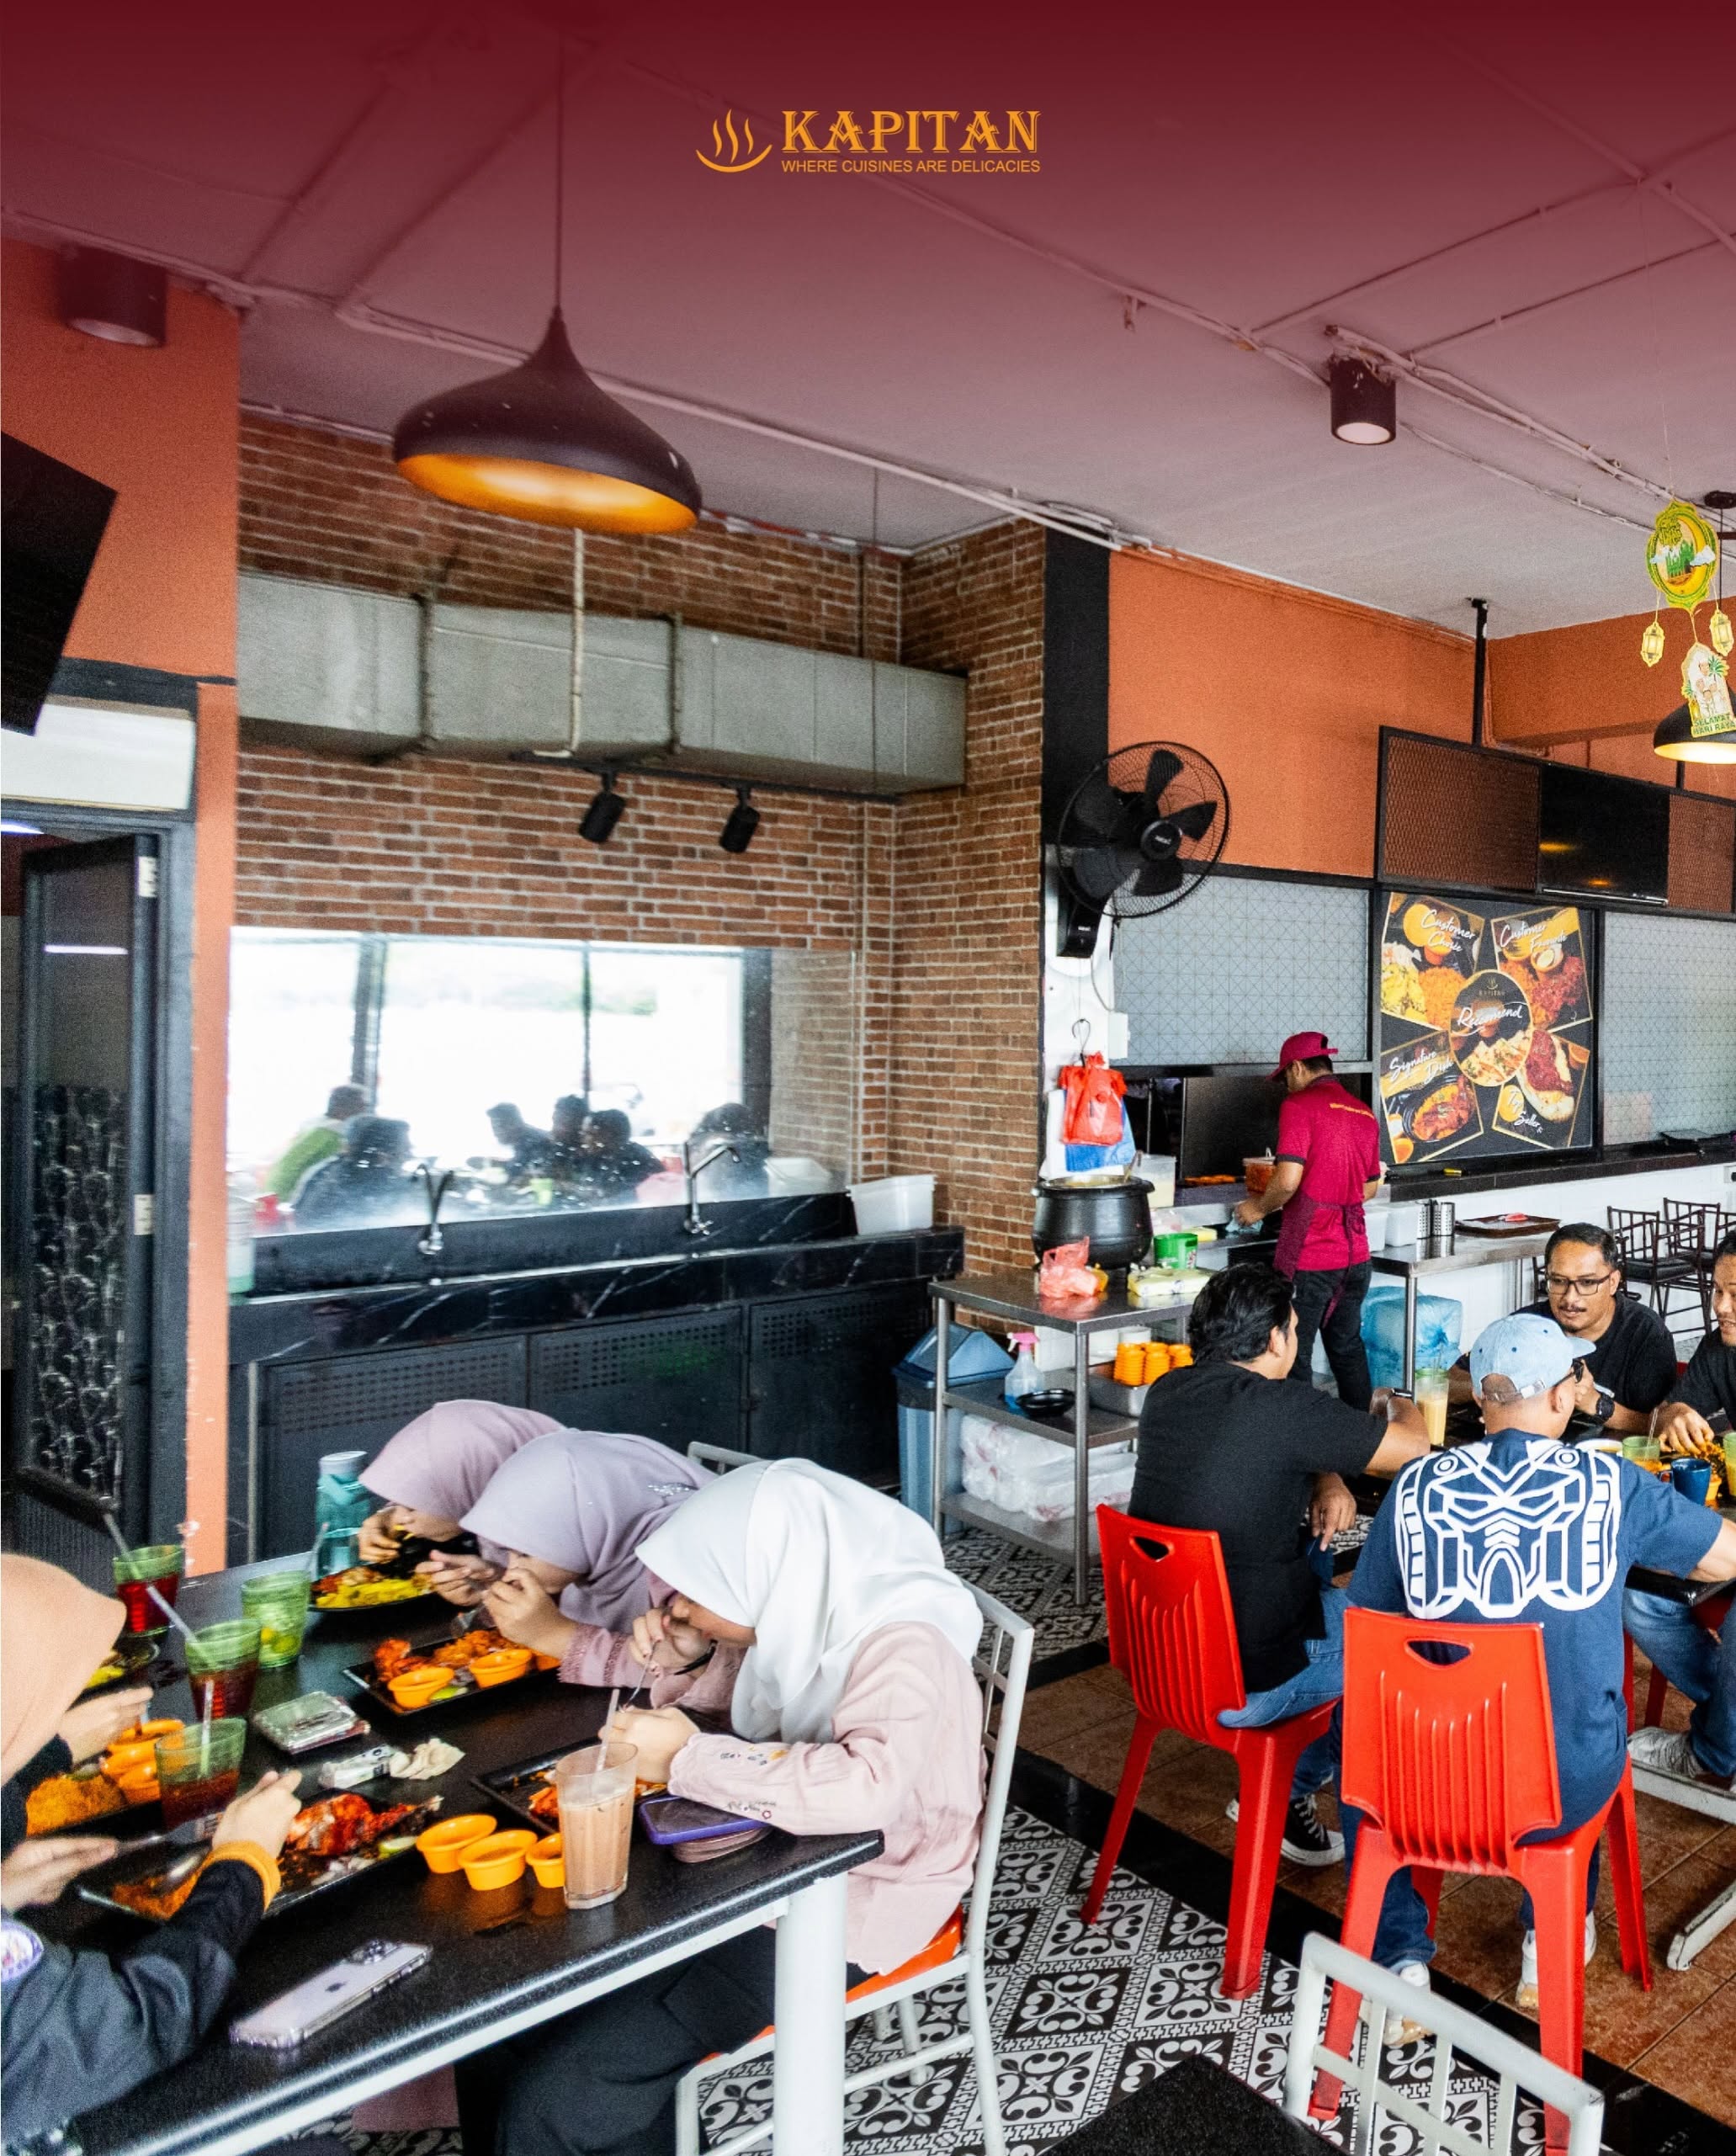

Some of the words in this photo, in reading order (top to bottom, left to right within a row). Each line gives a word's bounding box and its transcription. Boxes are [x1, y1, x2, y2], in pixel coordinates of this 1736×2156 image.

[1693, 725, 1712, 735] HARI
[1714, 721, 1735, 731] RAYA
[1694, 713, 1730, 726] SELAMAT
[1420, 909, 1476, 940] Customer
[1500, 921, 1547, 948] Customer
[1389, 1049, 1437, 1082] Signature
